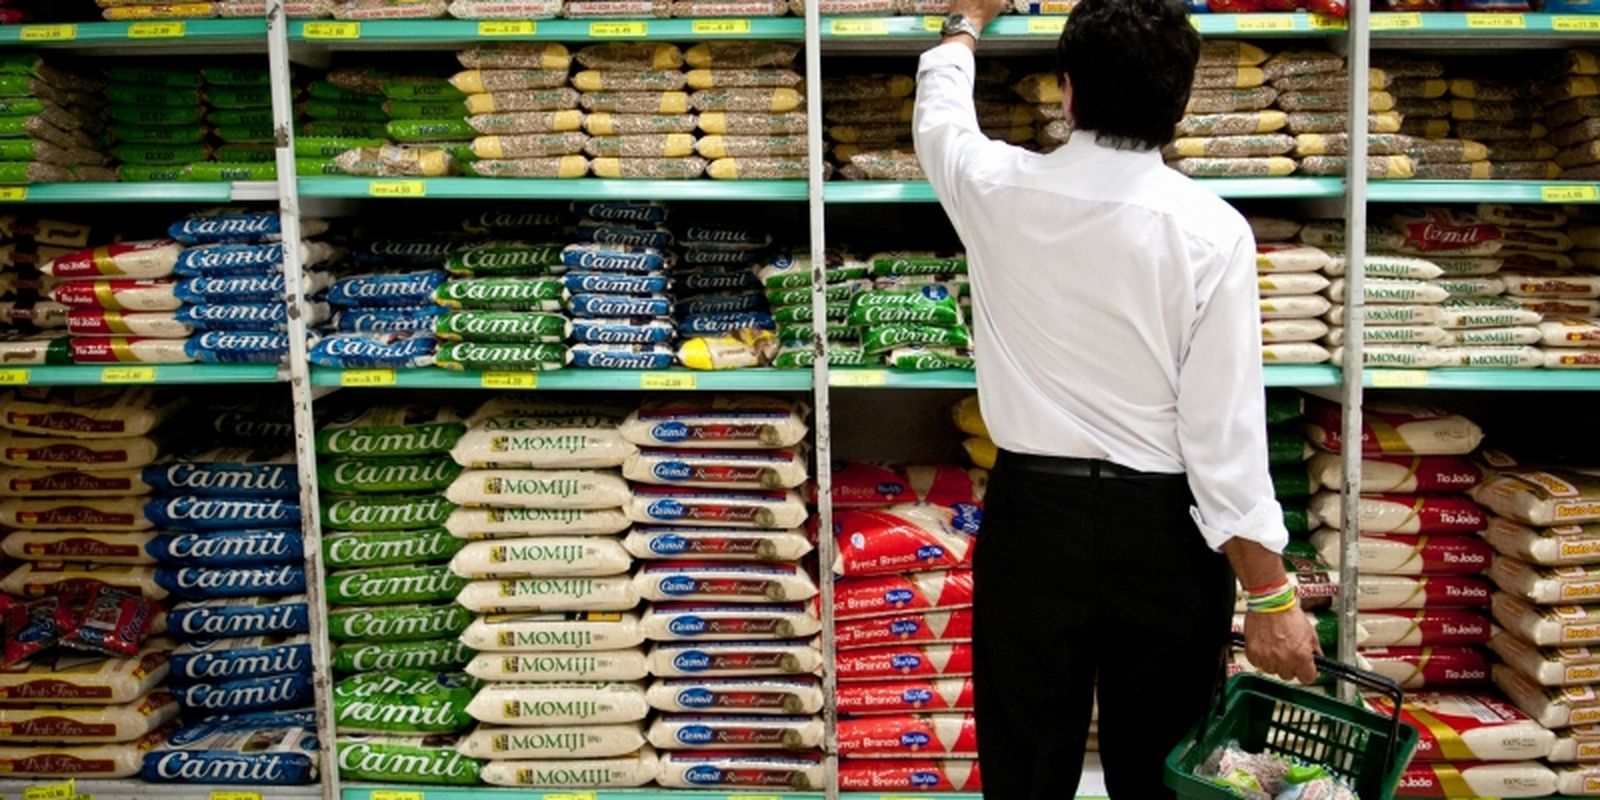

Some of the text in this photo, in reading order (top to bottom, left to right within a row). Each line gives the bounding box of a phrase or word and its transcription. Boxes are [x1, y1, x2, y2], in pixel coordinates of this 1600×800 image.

[588, 203, 653, 221] Camil
[183, 215, 271, 234] Camil
[1423, 223, 1480, 243] Camil
[592, 227, 659, 248] Camil
[186, 246, 281, 269] Camil
[462, 248, 551, 269] Camil
[580, 251, 648, 271] Camil
[892, 259, 957, 274] Camil
[190, 274, 286, 293] Camil
[342, 276, 432, 298] Camil
[449, 279, 547, 299] Camil
[582, 275, 652, 292] Camil
[686, 272, 746, 289] Camil
[1366, 288, 1416, 301] MOMIJI
[189, 302, 284, 320] Camil
[585, 297, 658, 315] Camil
[690, 296, 752, 315] Camil
[865, 306, 937, 322] Camil
[450, 312, 546, 333] Camil
[1366, 309, 1414, 322] MOMIJI
[1468, 315, 1514, 328] MOMIJI
[585, 324, 654, 343] Camil
[880, 328, 948, 345] Camil
[1366, 329, 1414, 343] MOMIJI
[1465, 332, 1514, 345] MOMIJI
[326, 338, 416, 357] Camil
[451, 342, 547, 361] Camil
[588, 352, 657, 370] Camil
[1369, 351, 1416, 366] MOMIJI
[1471, 354, 1520, 368] MOMIJI
[213, 411, 292, 437] Cam
[653, 426, 688, 438] Camil
[328, 426, 447, 452] Camil
[511, 435, 586, 454] MOMIJI
[167, 463, 286, 489] Camil
[335, 460, 450, 484] Camil
[655, 464, 689, 477] Camil
[504, 479, 580, 499] MOMIJI
[166, 495, 287, 519] Camil
[329, 499, 444, 524] Camil
[507, 509, 582, 524] MOMIJI
[649, 501, 683, 516] Camil
[168, 531, 288, 557] Camil
[330, 532, 446, 562] Camil
[651, 537, 685, 549] Camil
[510, 545, 583, 564] MOMIJI
[850, 554, 916, 570] Arroz Branco
[177, 565, 295, 588] Camil
[339, 569, 456, 598] Camil
[660, 579, 695, 592] Camil
[519, 579, 593, 598] MOMIJI
[848, 598, 885, 608] Branco
[181, 605, 297, 634] Camil
[344, 609, 462, 637] Camil
[671, 621, 705, 632] Camil
[517, 631, 591, 648] MOMIJI
[185, 647, 302, 679] Camil
[353, 639, 470, 671] Camil
[675, 654, 709, 668] Camil
[521, 656, 597, 675] MOMIJI
[855, 661, 891, 671] Branco
[185, 678, 296, 709] Camil
[680, 692, 713, 705] Camil
[865, 695, 901, 705] Branco
[523, 701, 597, 718] MOMIJI
[511, 732, 586, 751] MOMIJI
[678, 729, 712, 740] Camil
[838, 738, 899, 750] rroz Branco
[157, 751, 283, 781] Camil
[339, 743, 464, 776] Camil
[537, 768, 611, 787] MOMIJI
[687, 769, 720, 781] Camil
[842, 776, 909, 788] Arroz Branco
